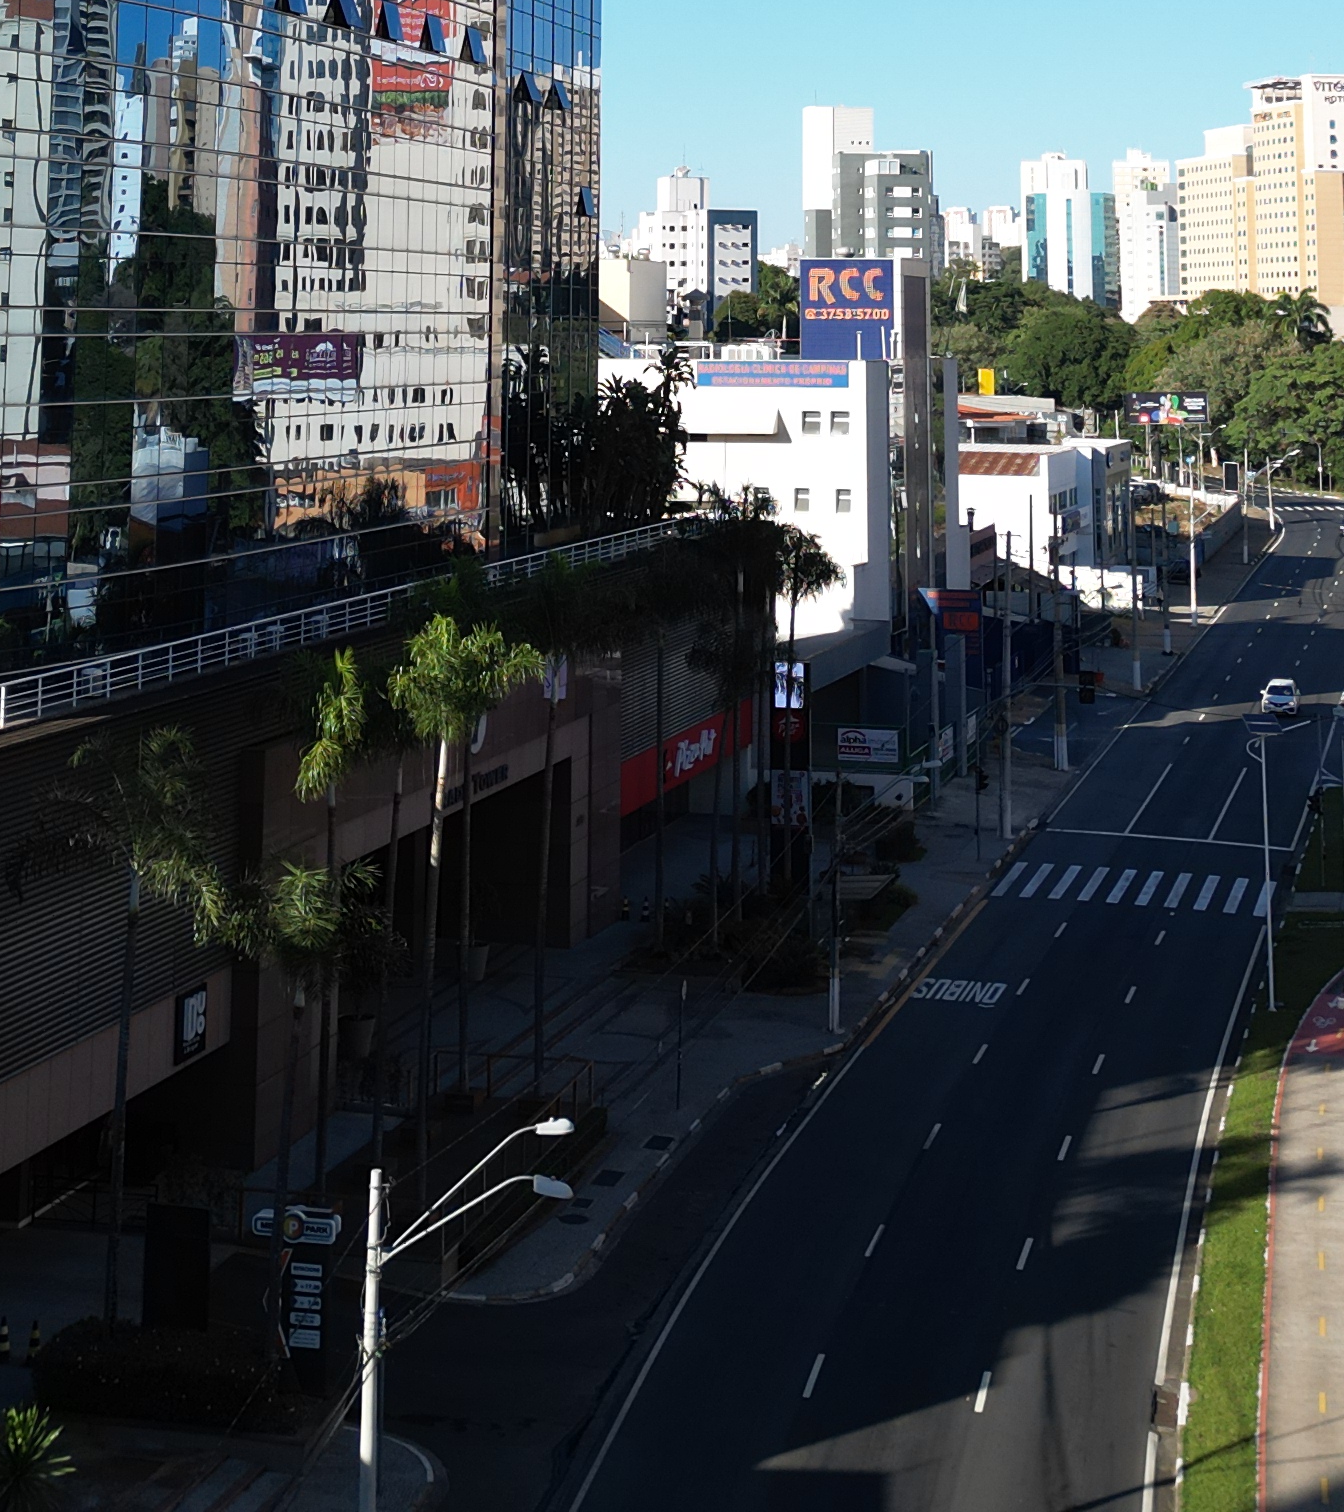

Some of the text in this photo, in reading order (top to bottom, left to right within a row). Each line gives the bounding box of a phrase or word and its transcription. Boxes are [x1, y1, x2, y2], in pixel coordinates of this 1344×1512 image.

[808, 268, 885, 305] RCC
[840, 734, 867, 745] alpha
[839, 746, 870, 754] ALUGA
[305, 1224, 328, 1234] PARK
